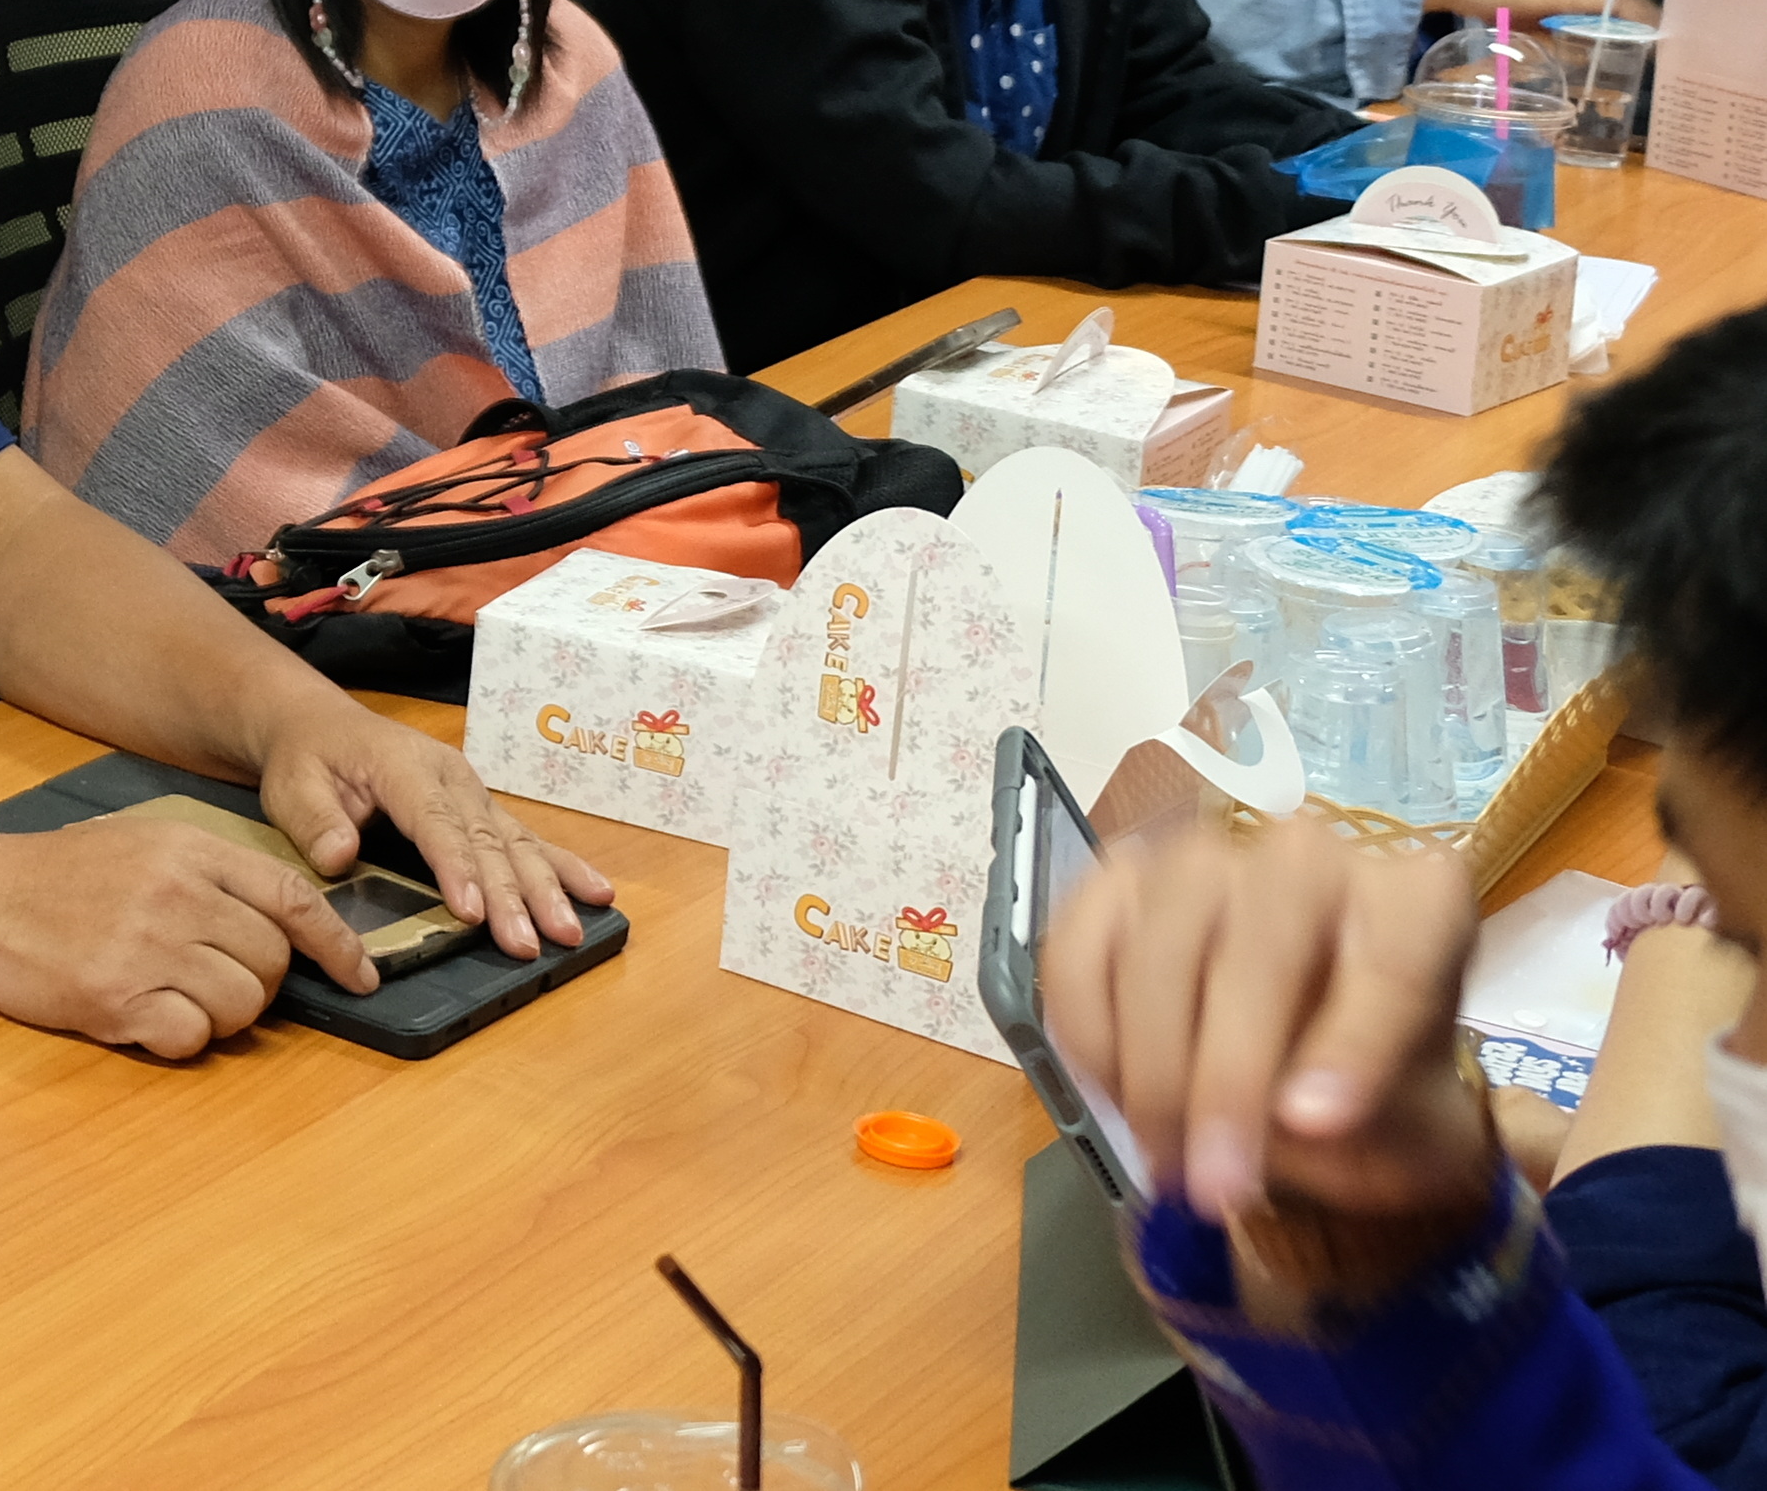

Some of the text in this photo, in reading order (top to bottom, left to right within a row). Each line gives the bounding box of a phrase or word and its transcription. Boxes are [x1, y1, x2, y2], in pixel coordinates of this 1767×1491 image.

[824, 582, 870, 673] CAKE
[535, 704, 628, 762] CAKE
[793, 893, 892, 962] CAKE
